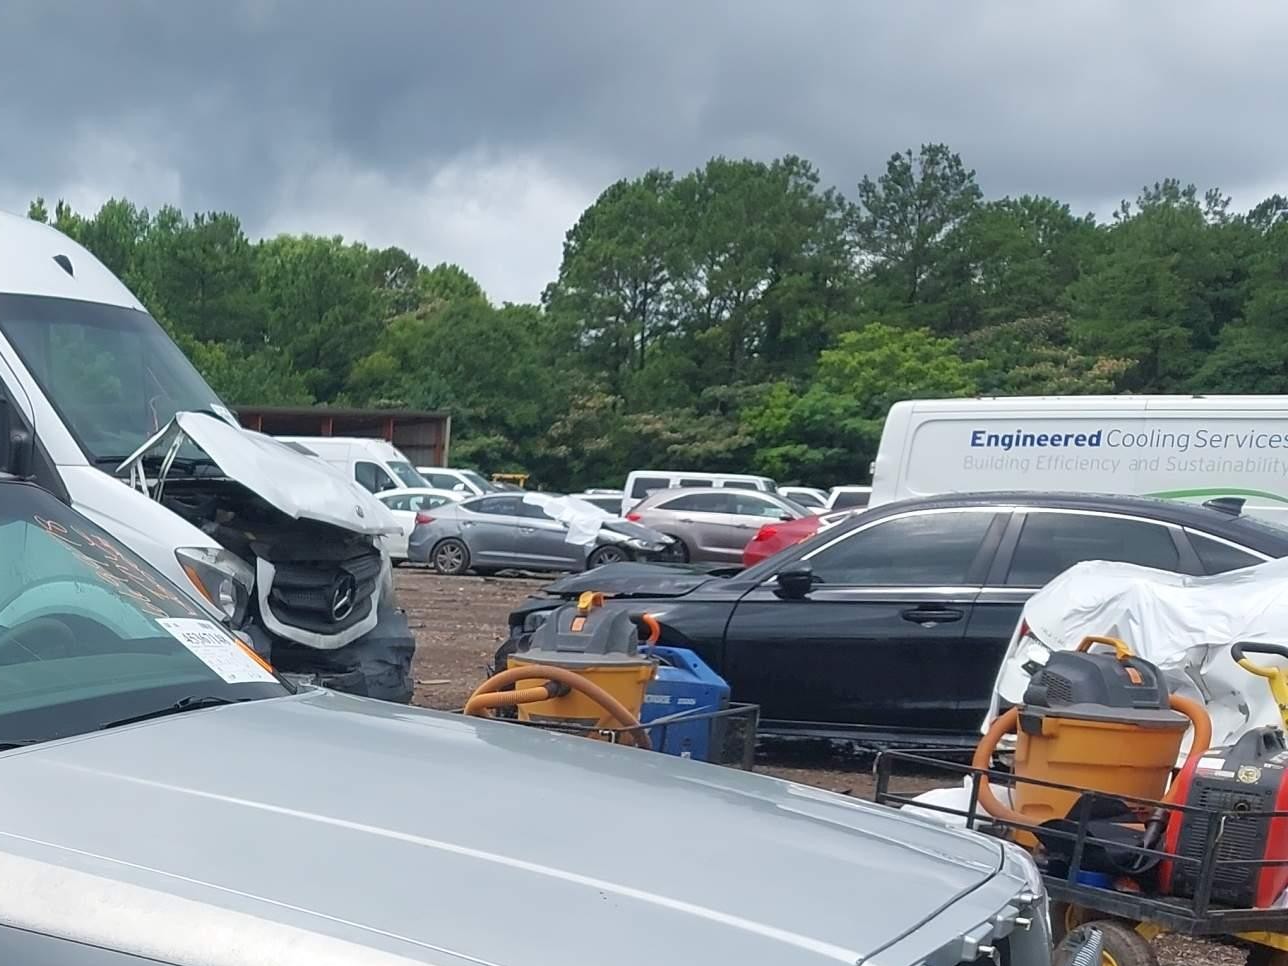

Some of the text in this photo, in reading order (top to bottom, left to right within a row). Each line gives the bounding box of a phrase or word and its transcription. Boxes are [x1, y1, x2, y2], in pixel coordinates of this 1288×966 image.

[971, 429, 1102, 451] Engineered
[1107, 429, 1190, 452] Cooling
[963, 455, 1288, 476] Building Efficiency and Sustainability
